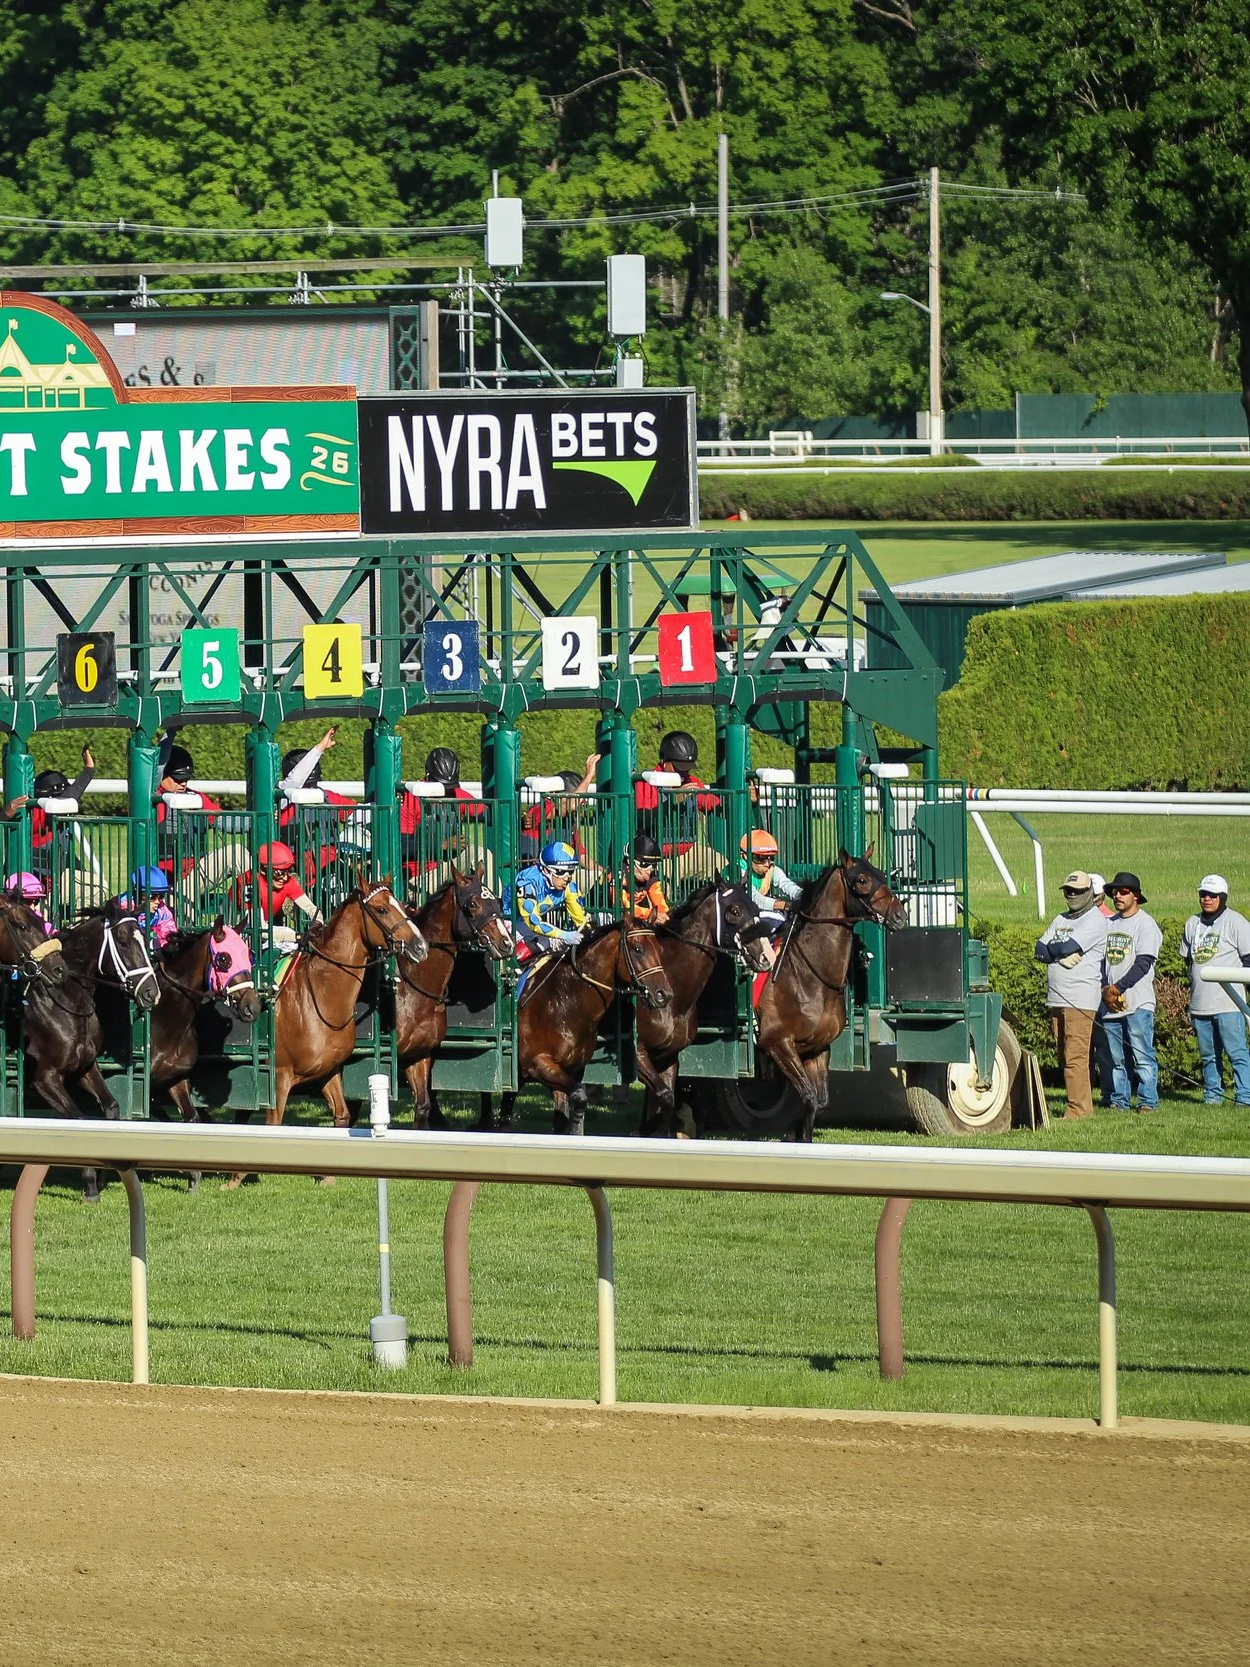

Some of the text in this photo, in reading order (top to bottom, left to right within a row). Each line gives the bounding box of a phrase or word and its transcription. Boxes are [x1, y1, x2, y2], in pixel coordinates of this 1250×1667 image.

[60, 428, 291, 494] STAKES
[310, 446, 348, 474] 26
[387, 411, 658, 512] NYRA BETS
[75, 643, 98, 693] 6
[201, 640, 223, 689] 5
[321, 638, 342, 683] 4
[442, 633, 463, 681] 3
[561, 631, 581, 676] 2
[677, 625, 694, 672] 1
